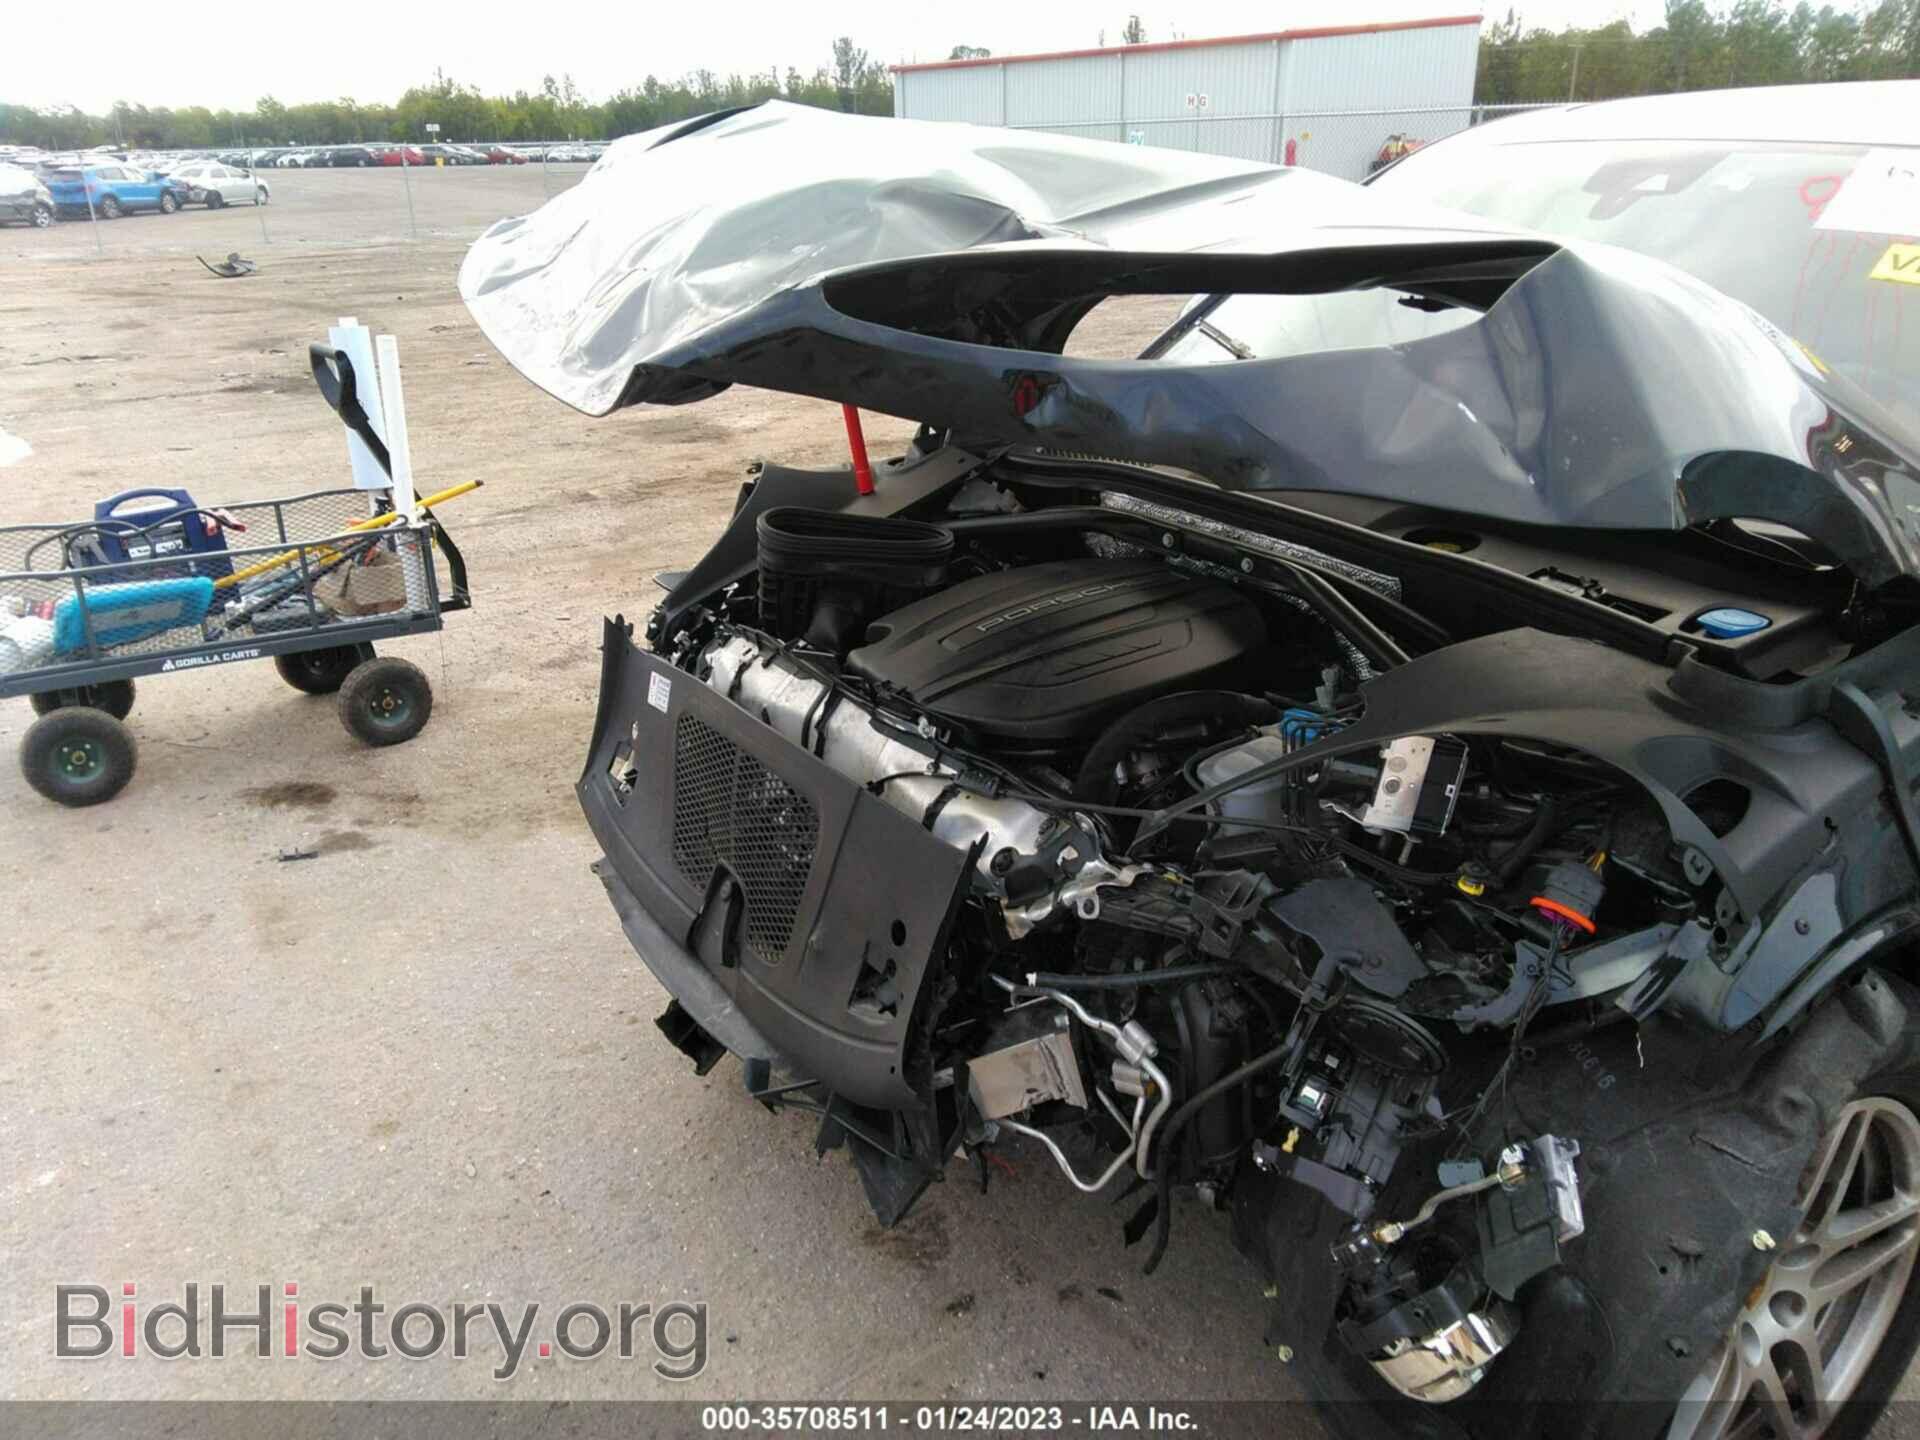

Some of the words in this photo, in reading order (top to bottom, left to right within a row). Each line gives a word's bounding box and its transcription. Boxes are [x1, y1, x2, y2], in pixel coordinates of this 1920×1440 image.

[975, 579, 1138, 632] PORSCH
[175, 653, 221, 668] GORILLA
[222, 649, 259, 661] CARTS
